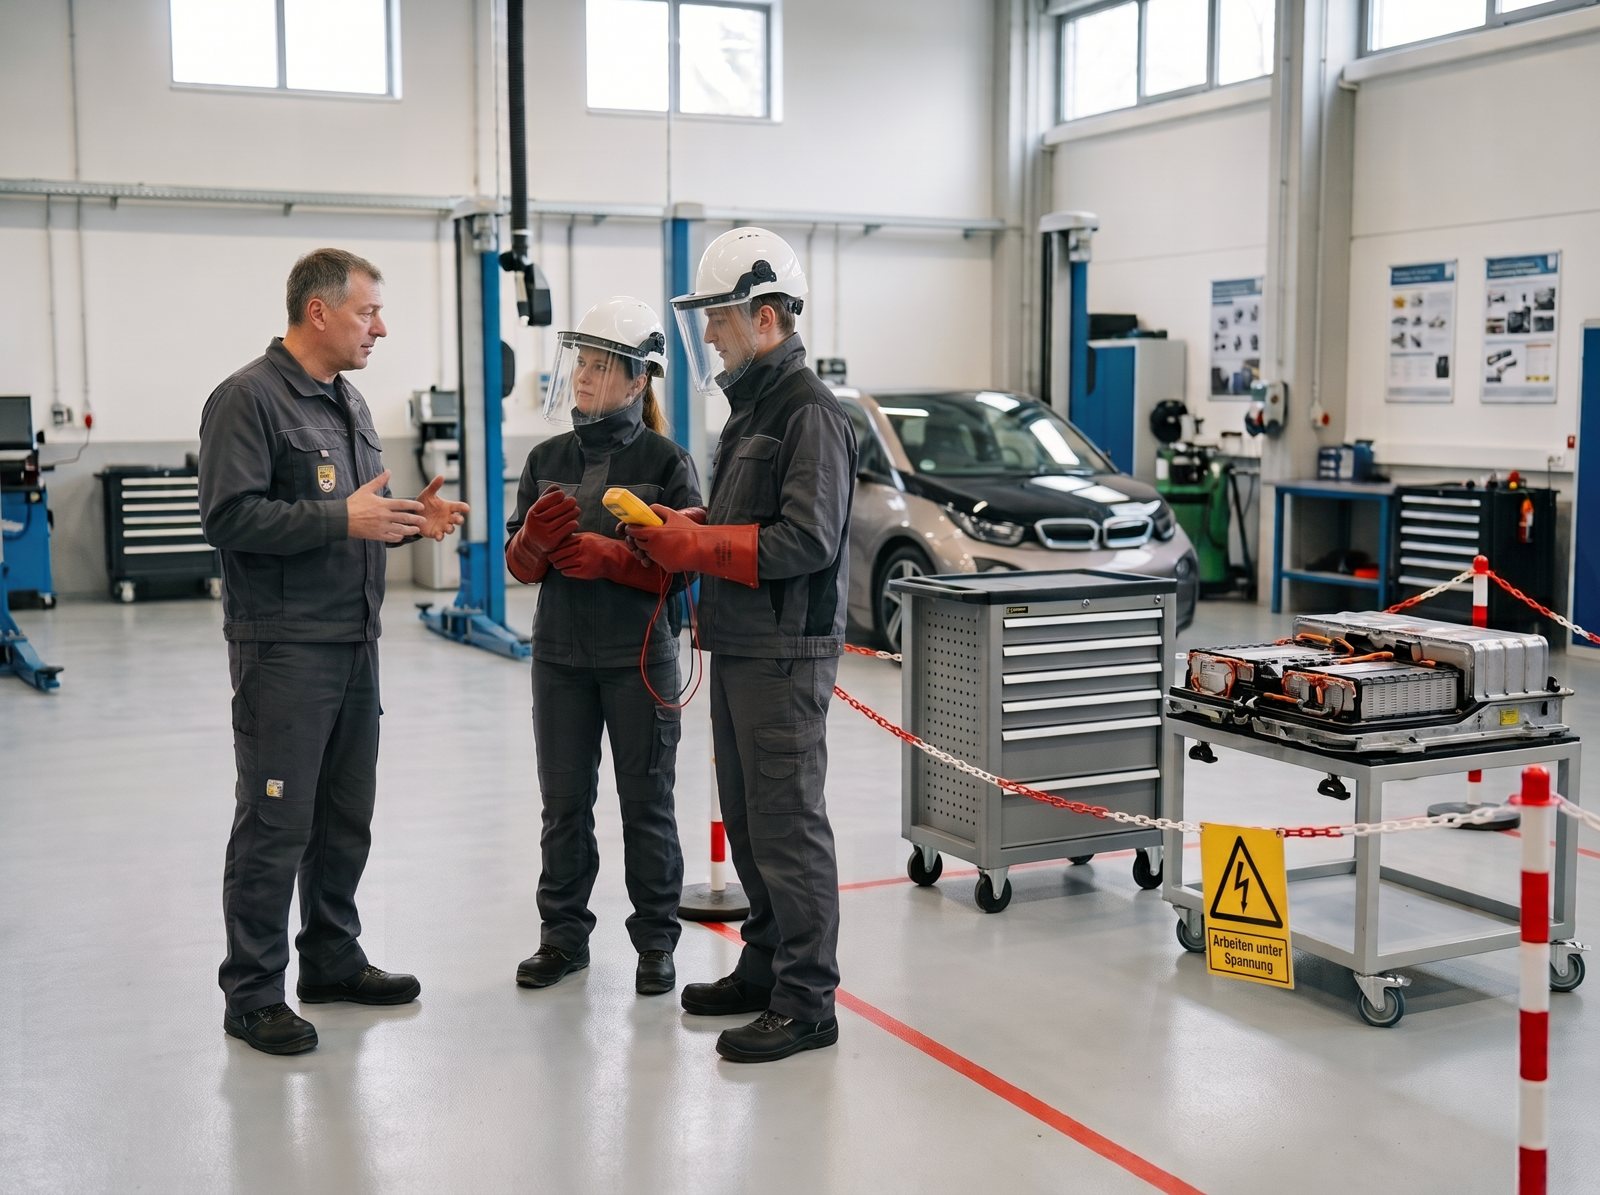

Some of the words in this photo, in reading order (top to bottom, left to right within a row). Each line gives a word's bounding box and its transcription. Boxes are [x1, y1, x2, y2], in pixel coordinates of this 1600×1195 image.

[1213, 934, 1254, 952] Arbeiten
[1256, 943, 1283, 957] unter
[1224, 952, 1273, 975] Spannung
